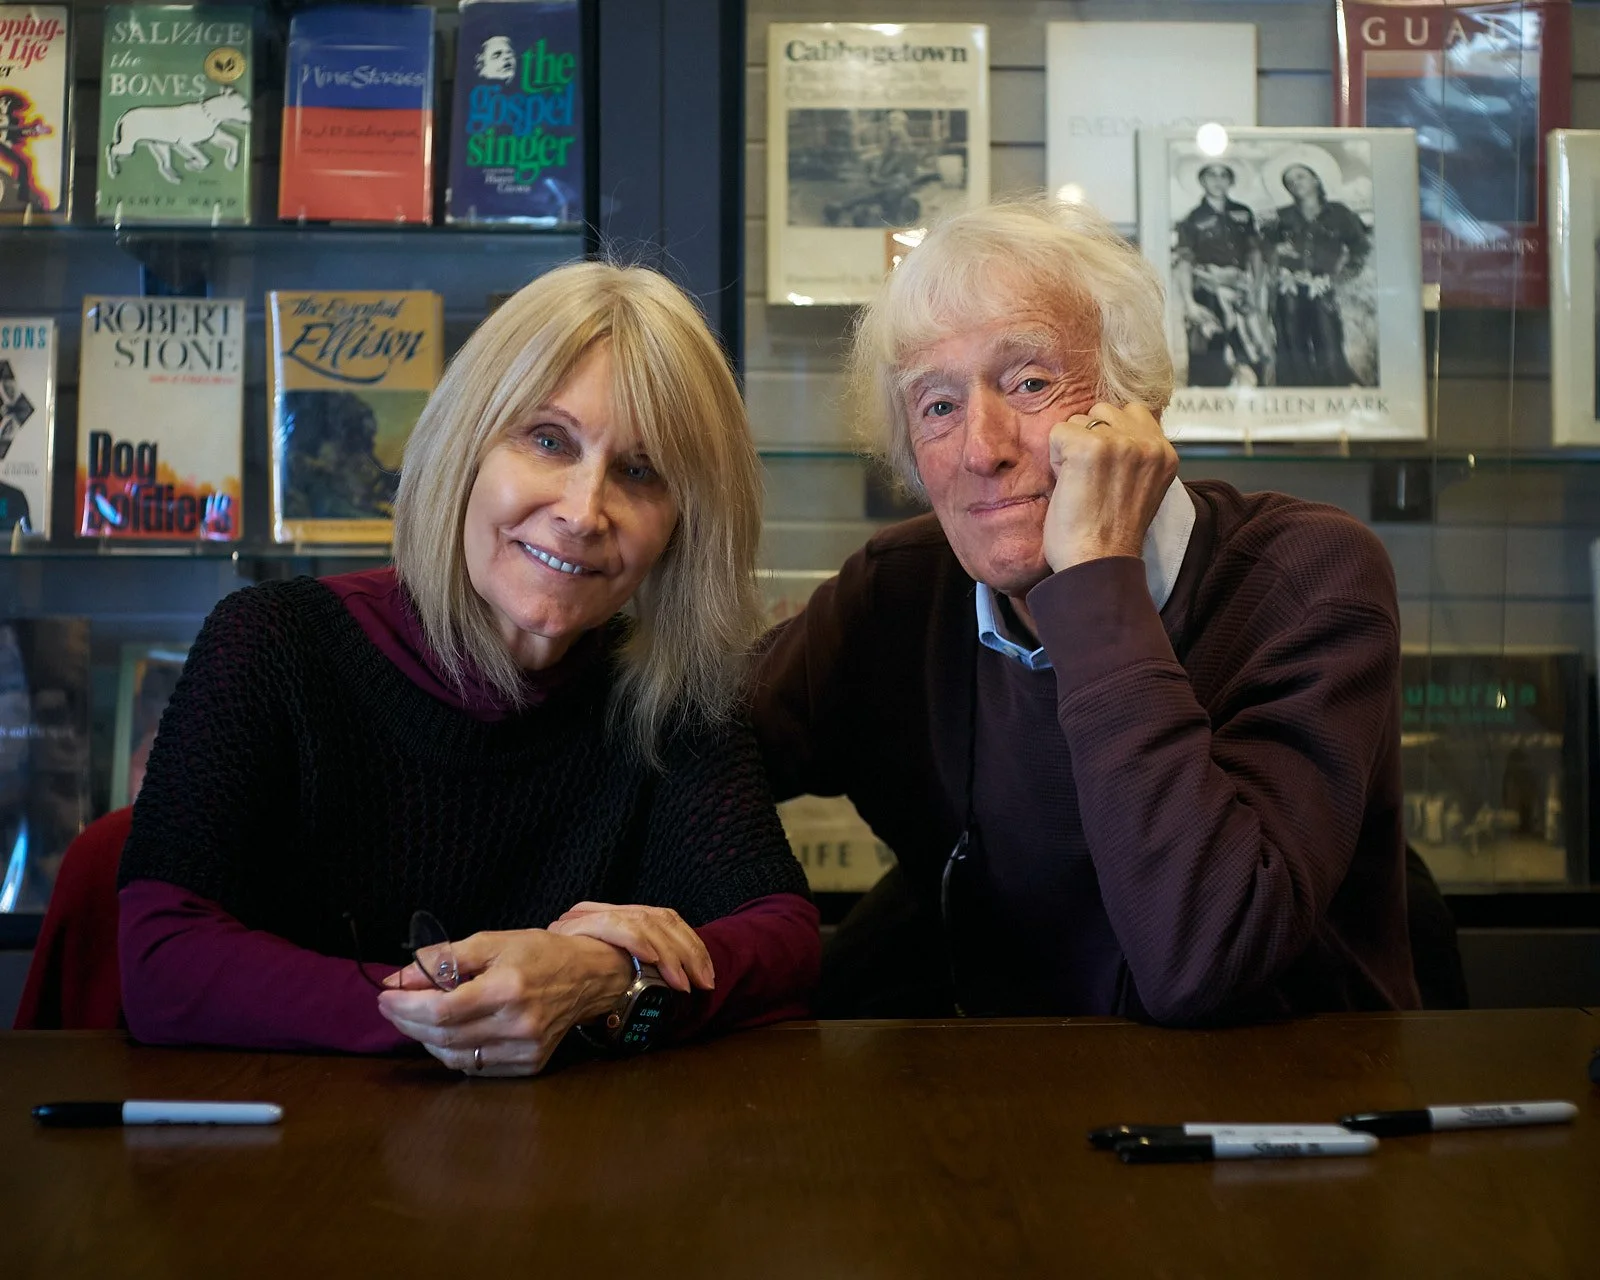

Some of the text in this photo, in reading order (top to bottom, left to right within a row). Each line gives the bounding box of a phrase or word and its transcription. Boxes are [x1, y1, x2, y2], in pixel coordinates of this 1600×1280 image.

[111, 20, 246, 45] SALVAGE
[9, 38, 48, 69] Life
[109, 50, 142, 68] the
[520, 37, 576, 94] the
[786, 39, 967, 64] Cabbagetown
[109, 73, 207, 97] BONES
[466, 84, 574, 136] gospel
[467, 129, 576, 184] singer
[94, 301, 239, 337] ROBERT
[1, 326, 47, 350] SONS
[281, 316, 427, 383] Ellison
[115, 338, 240, 371] STONE
[1177, 396, 1391, 414] MARY ELLEN MARK
[89, 431, 158, 483] Dog
[800, 841, 852, 868] IFE
